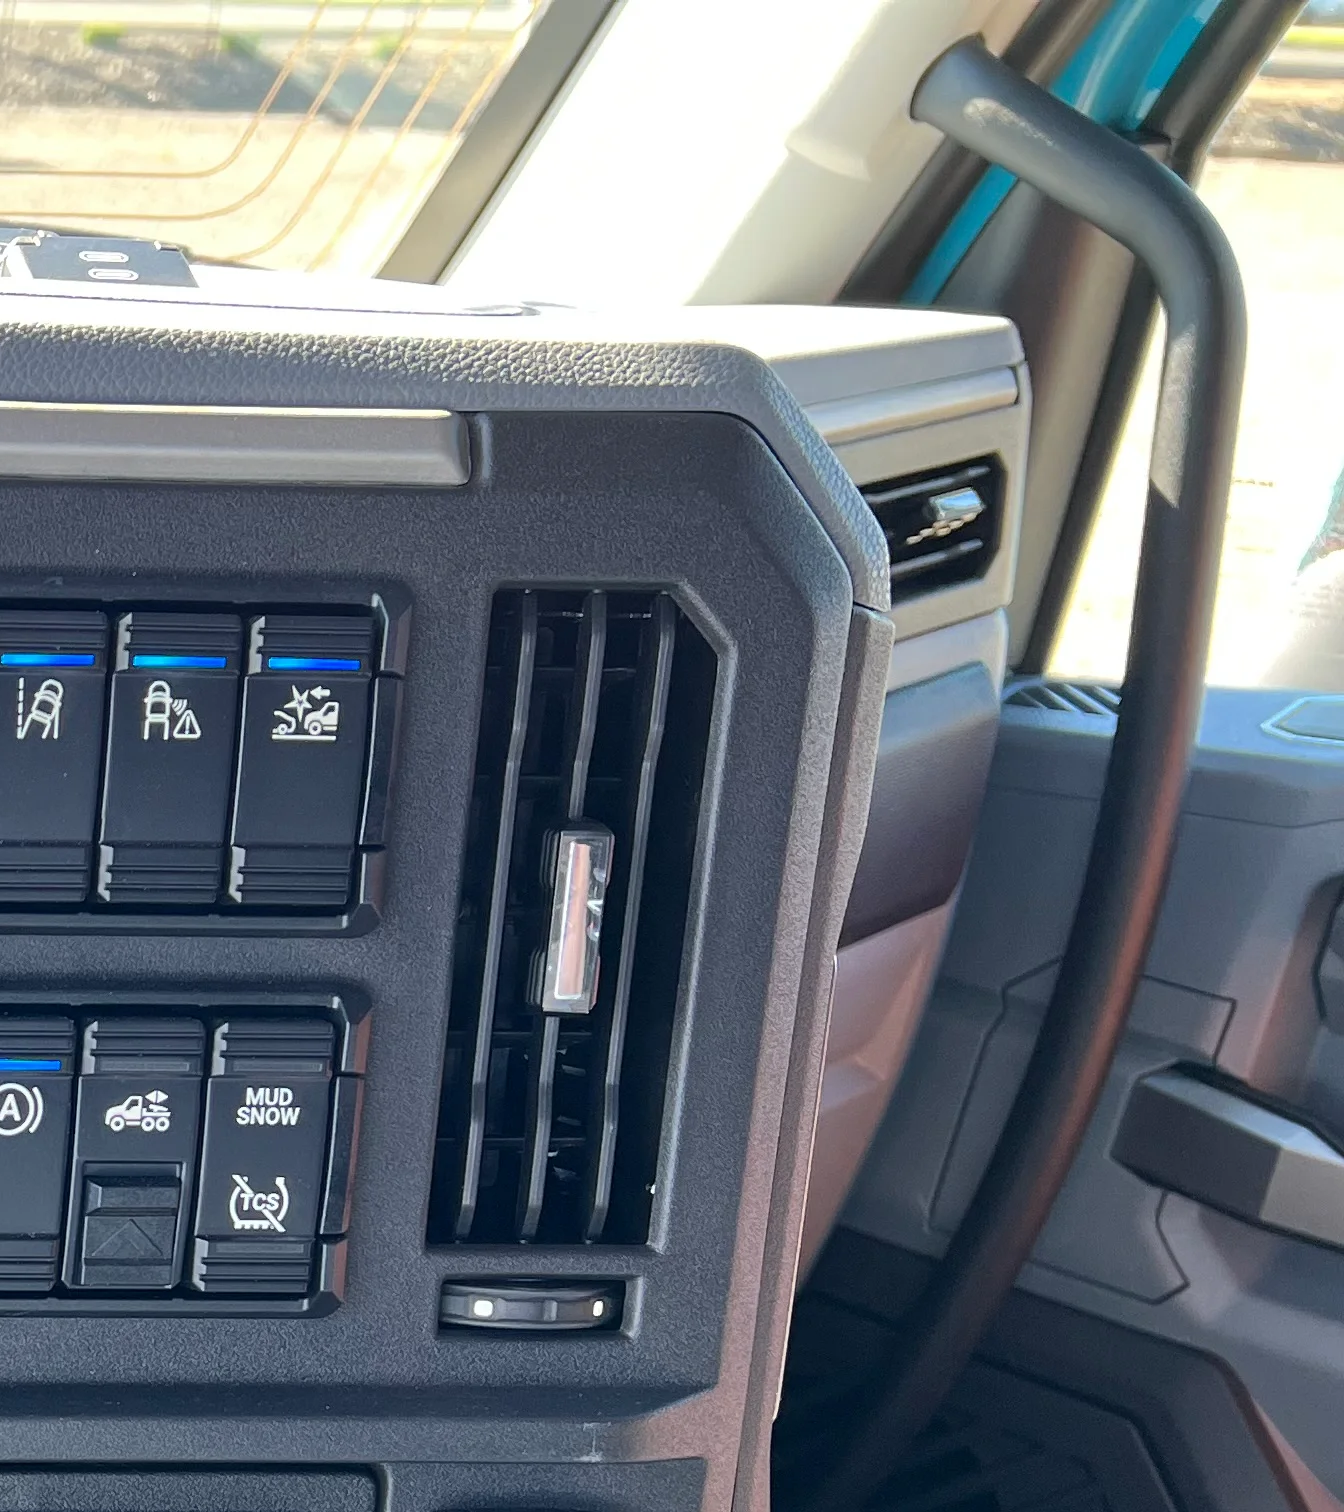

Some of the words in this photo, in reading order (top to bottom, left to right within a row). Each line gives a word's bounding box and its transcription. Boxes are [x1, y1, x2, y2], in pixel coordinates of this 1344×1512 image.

[245, 1087, 294, 1107] MUD
[235, 1107, 301, 1126] SNOW
[239, 1191, 280, 1212] TCS
